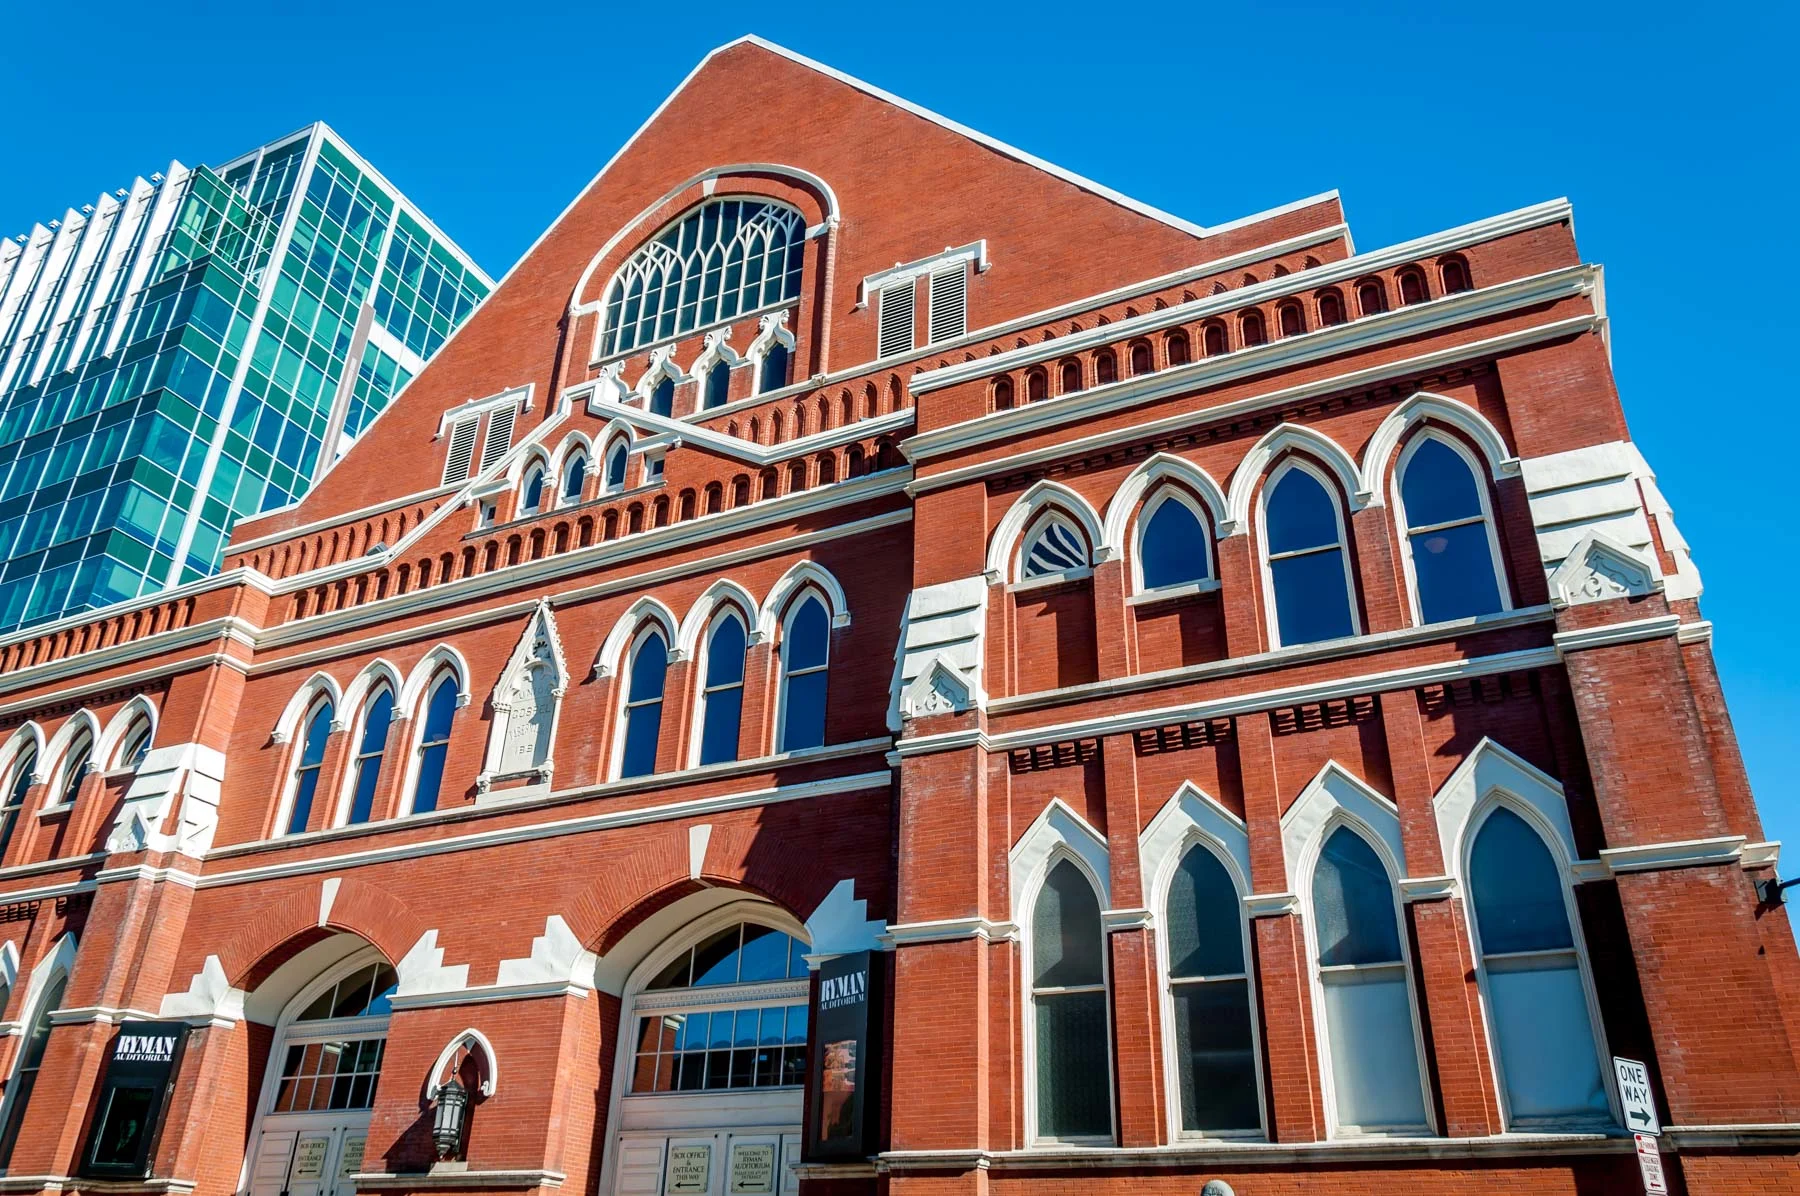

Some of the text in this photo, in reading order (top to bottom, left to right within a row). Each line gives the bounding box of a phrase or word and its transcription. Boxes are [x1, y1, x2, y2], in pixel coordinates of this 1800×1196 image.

[512, 703, 552, 719] GOSPEL
[821, 970, 866, 1002] RYMAN
[821, 993, 864, 1010] AUDITORIUM
[115, 1035, 178, 1054] RYMAN
[113, 1053, 173, 1062] AUDITORIUM
[1620, 1065, 1645, 1085] ONE
[1622, 1084, 1648, 1104] WAY
[673, 1151, 706, 1159] BOX OFFICE
[672, 1165, 705, 1173] ENTRANCE
[734, 1162, 771, 1170] AUDITORIUM
